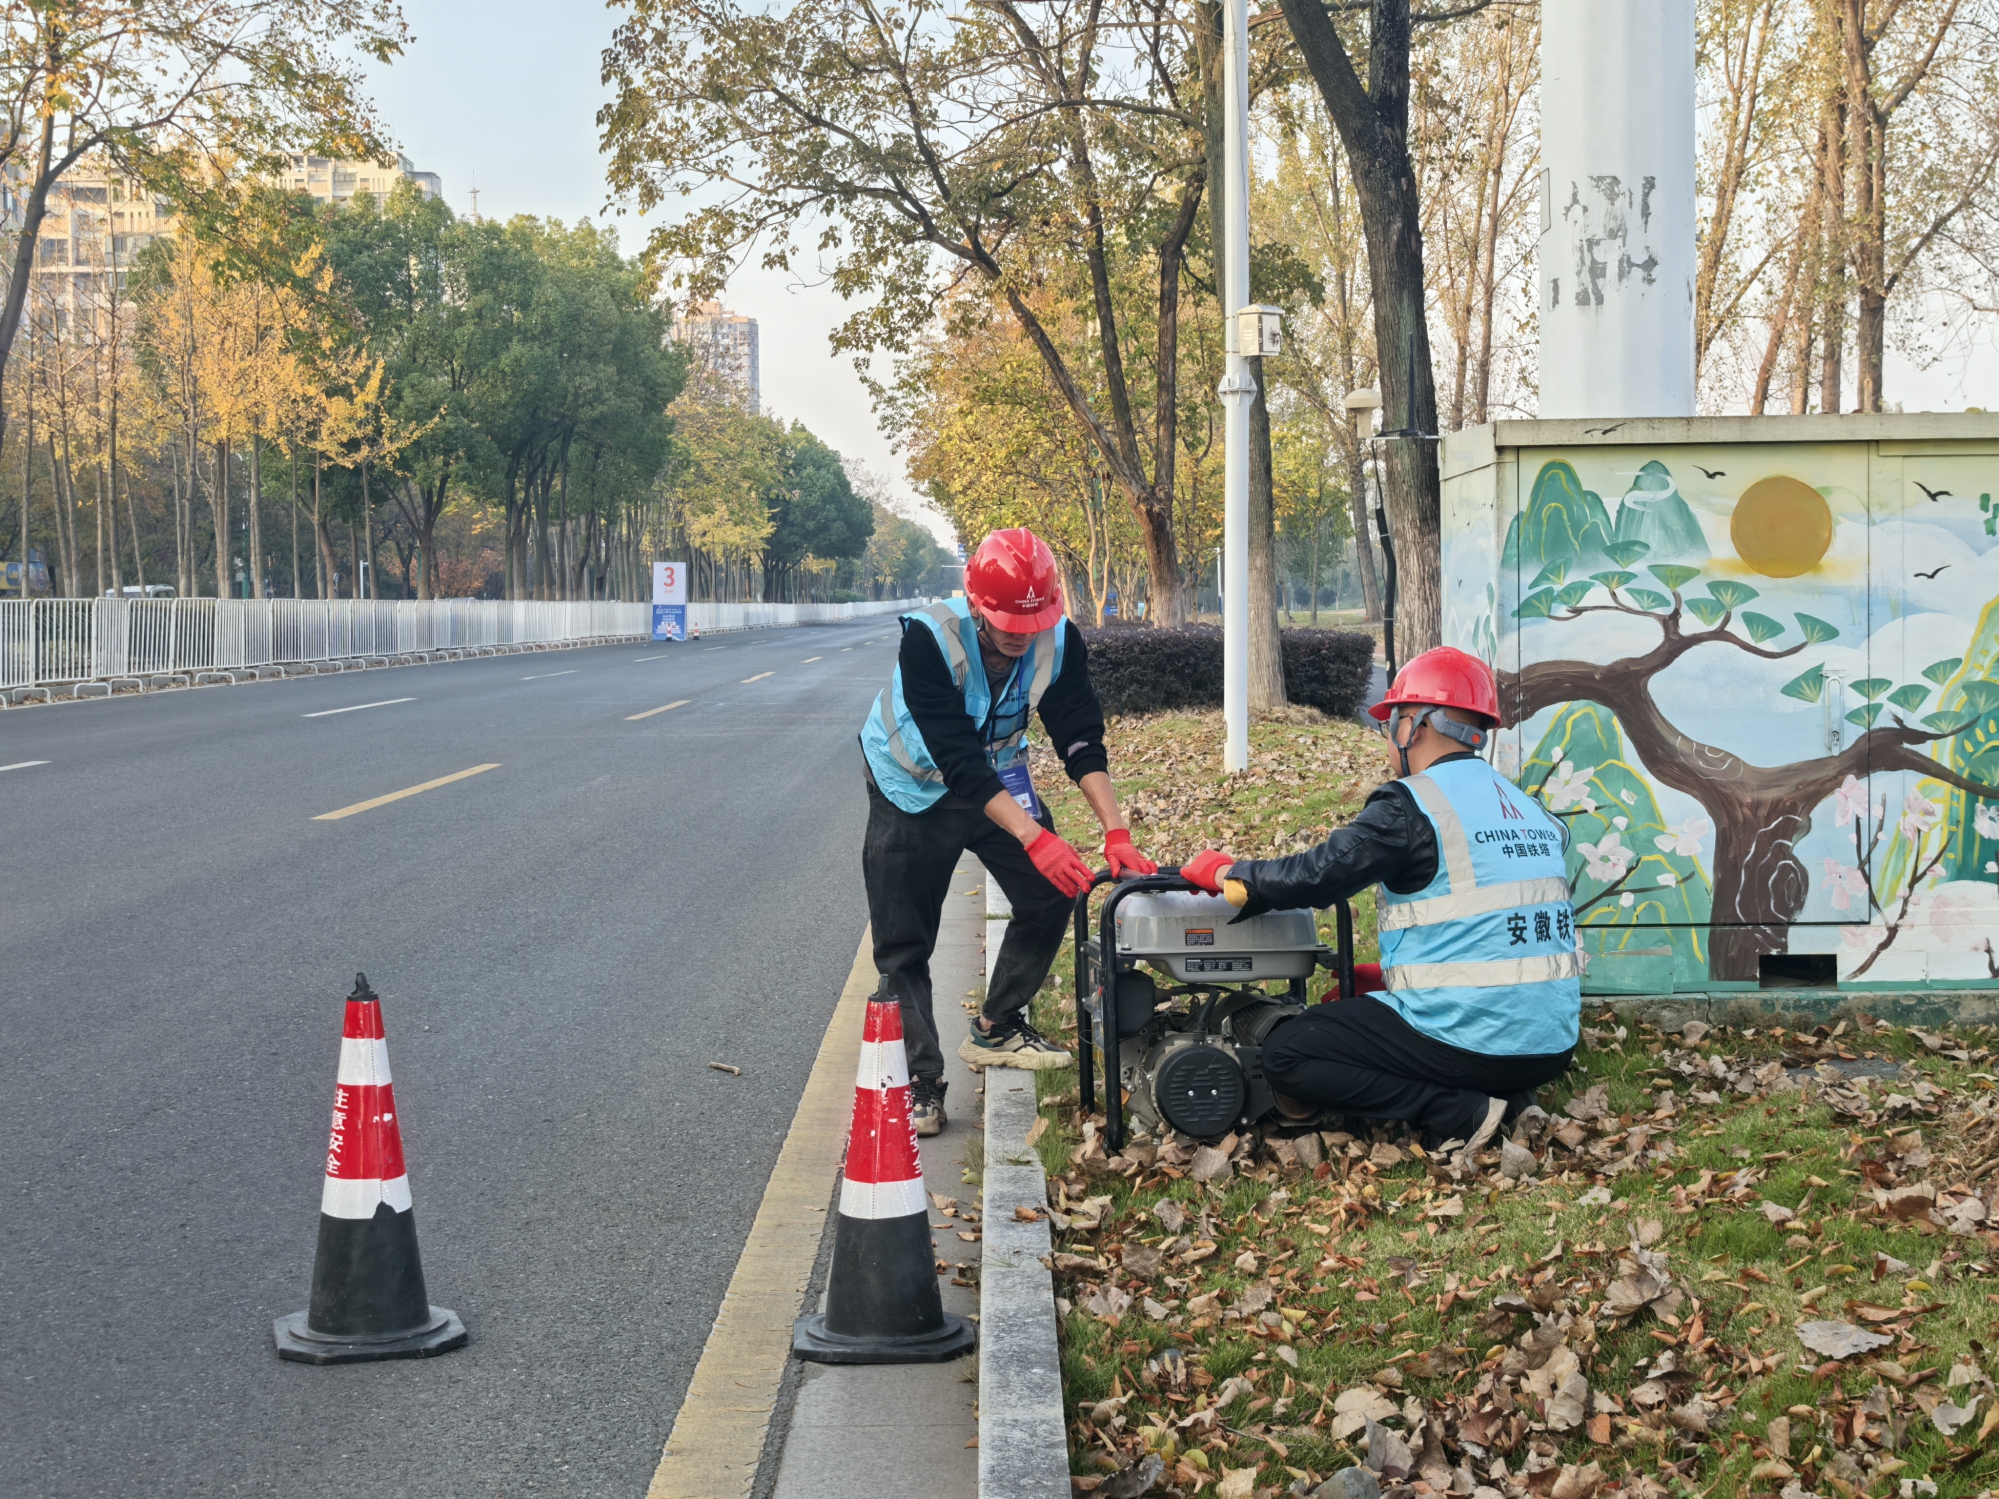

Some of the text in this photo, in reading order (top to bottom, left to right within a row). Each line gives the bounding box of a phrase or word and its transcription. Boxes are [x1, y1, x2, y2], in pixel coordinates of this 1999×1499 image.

[663, 566, 675, 587] 3
[1475, 829, 1560, 844] CHINA TOWER
[1502, 843, 1550, 858] 中国铁塔
[1507, 908, 1575, 946] 安徽铁
